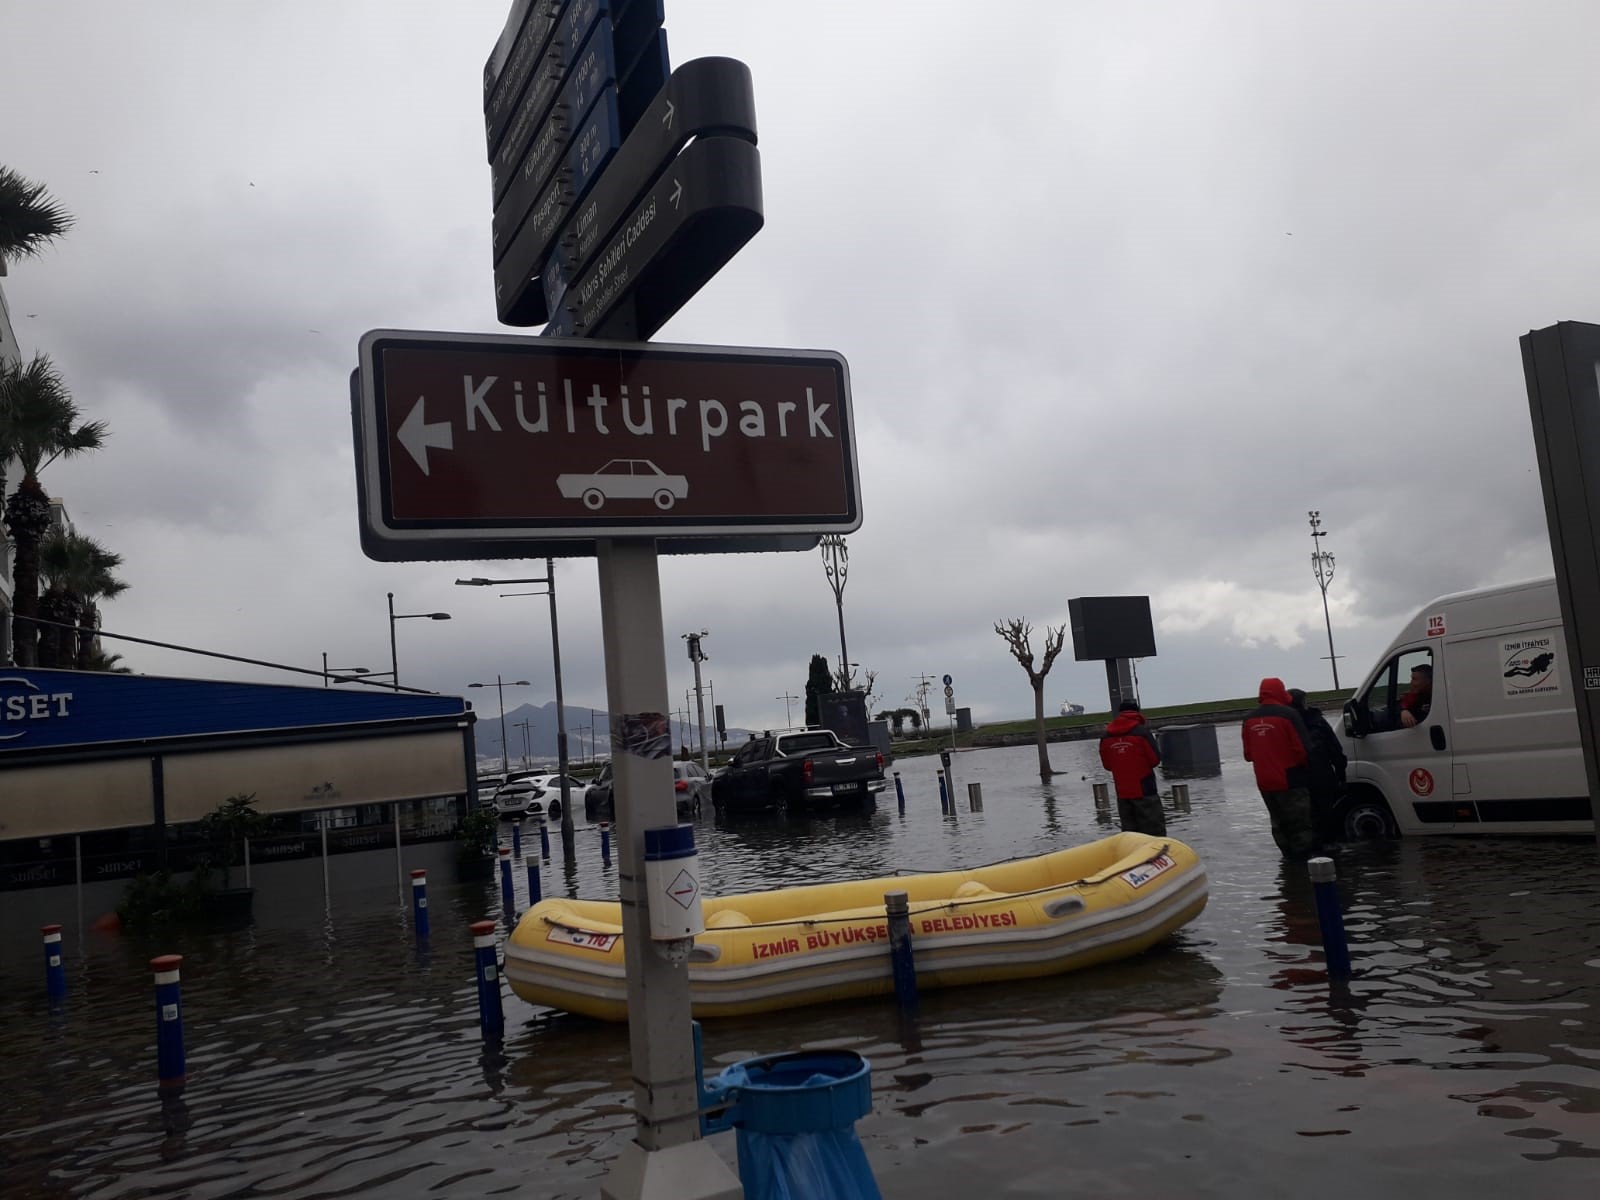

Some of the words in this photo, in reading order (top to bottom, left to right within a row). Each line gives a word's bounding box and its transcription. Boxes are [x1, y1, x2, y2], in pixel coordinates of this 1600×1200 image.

[532, 182, 561, 232] Pasaport
[576, 201, 598, 239] Liman
[626, 196, 657, 248] Caddesi
[463, 374, 835, 453] Kültürpark
[1429, 616, 1443, 628] 112
[0, 692, 73, 721] SET
[752, 937, 799, 960] İZMİR
[807, 922, 915, 951] BÜYÜKŞE
[922, 909, 1017, 933] BELEDİYESİ
